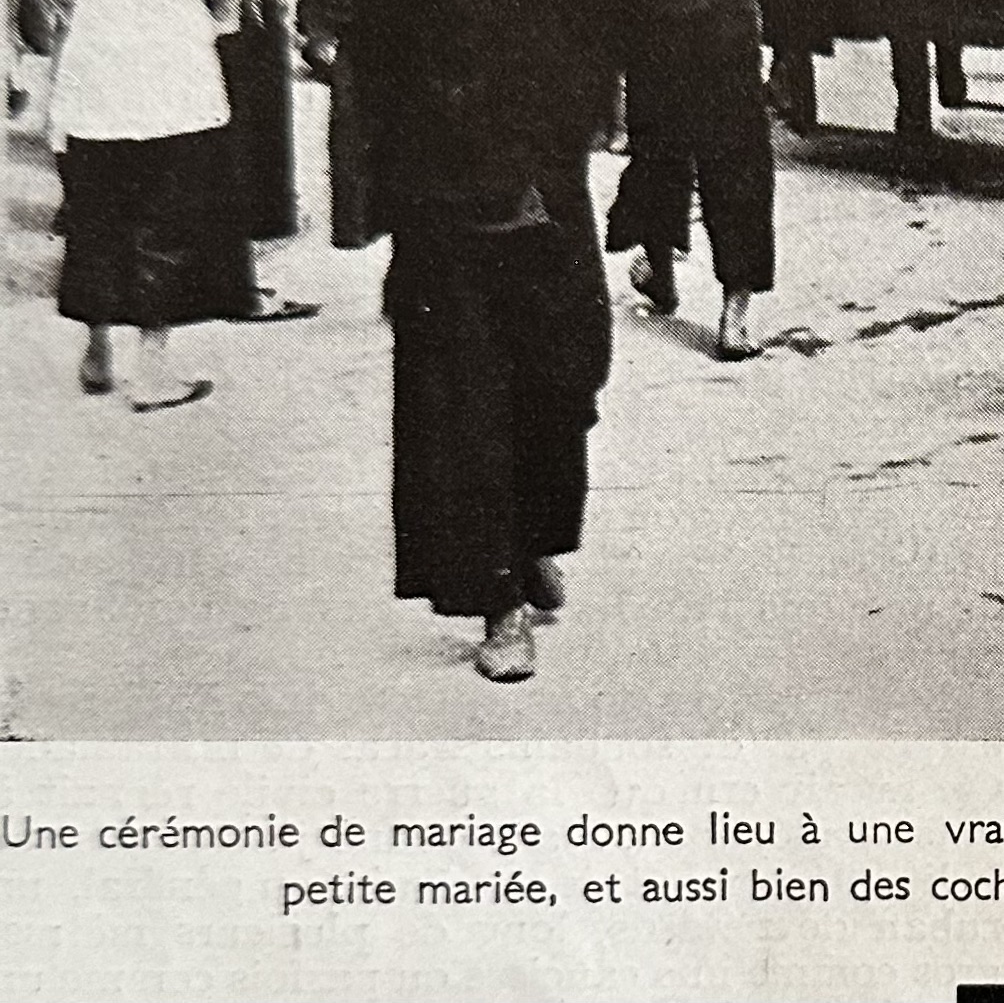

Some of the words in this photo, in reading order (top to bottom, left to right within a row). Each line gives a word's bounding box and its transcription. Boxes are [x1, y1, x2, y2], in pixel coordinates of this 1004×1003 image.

[3, 814, 79, 848] Une
[99, 813, 299, 848] cérémonie
[320, 814, 366, 847] de
[393, 813, 541, 855] mariage
[566, 813, 684, 846] donne
[710, 811, 775, 844] lieu
[801, 812, 821, 844] à
[848, 820, 914, 843] une
[283, 871, 396, 915] petite
[418, 870, 557, 906] mariée,
[583, 874, 622, 903] et
[642, 867, 729, 902] aussi
[751, 867, 829, 901] bien
[850, 868, 910, 901] des
